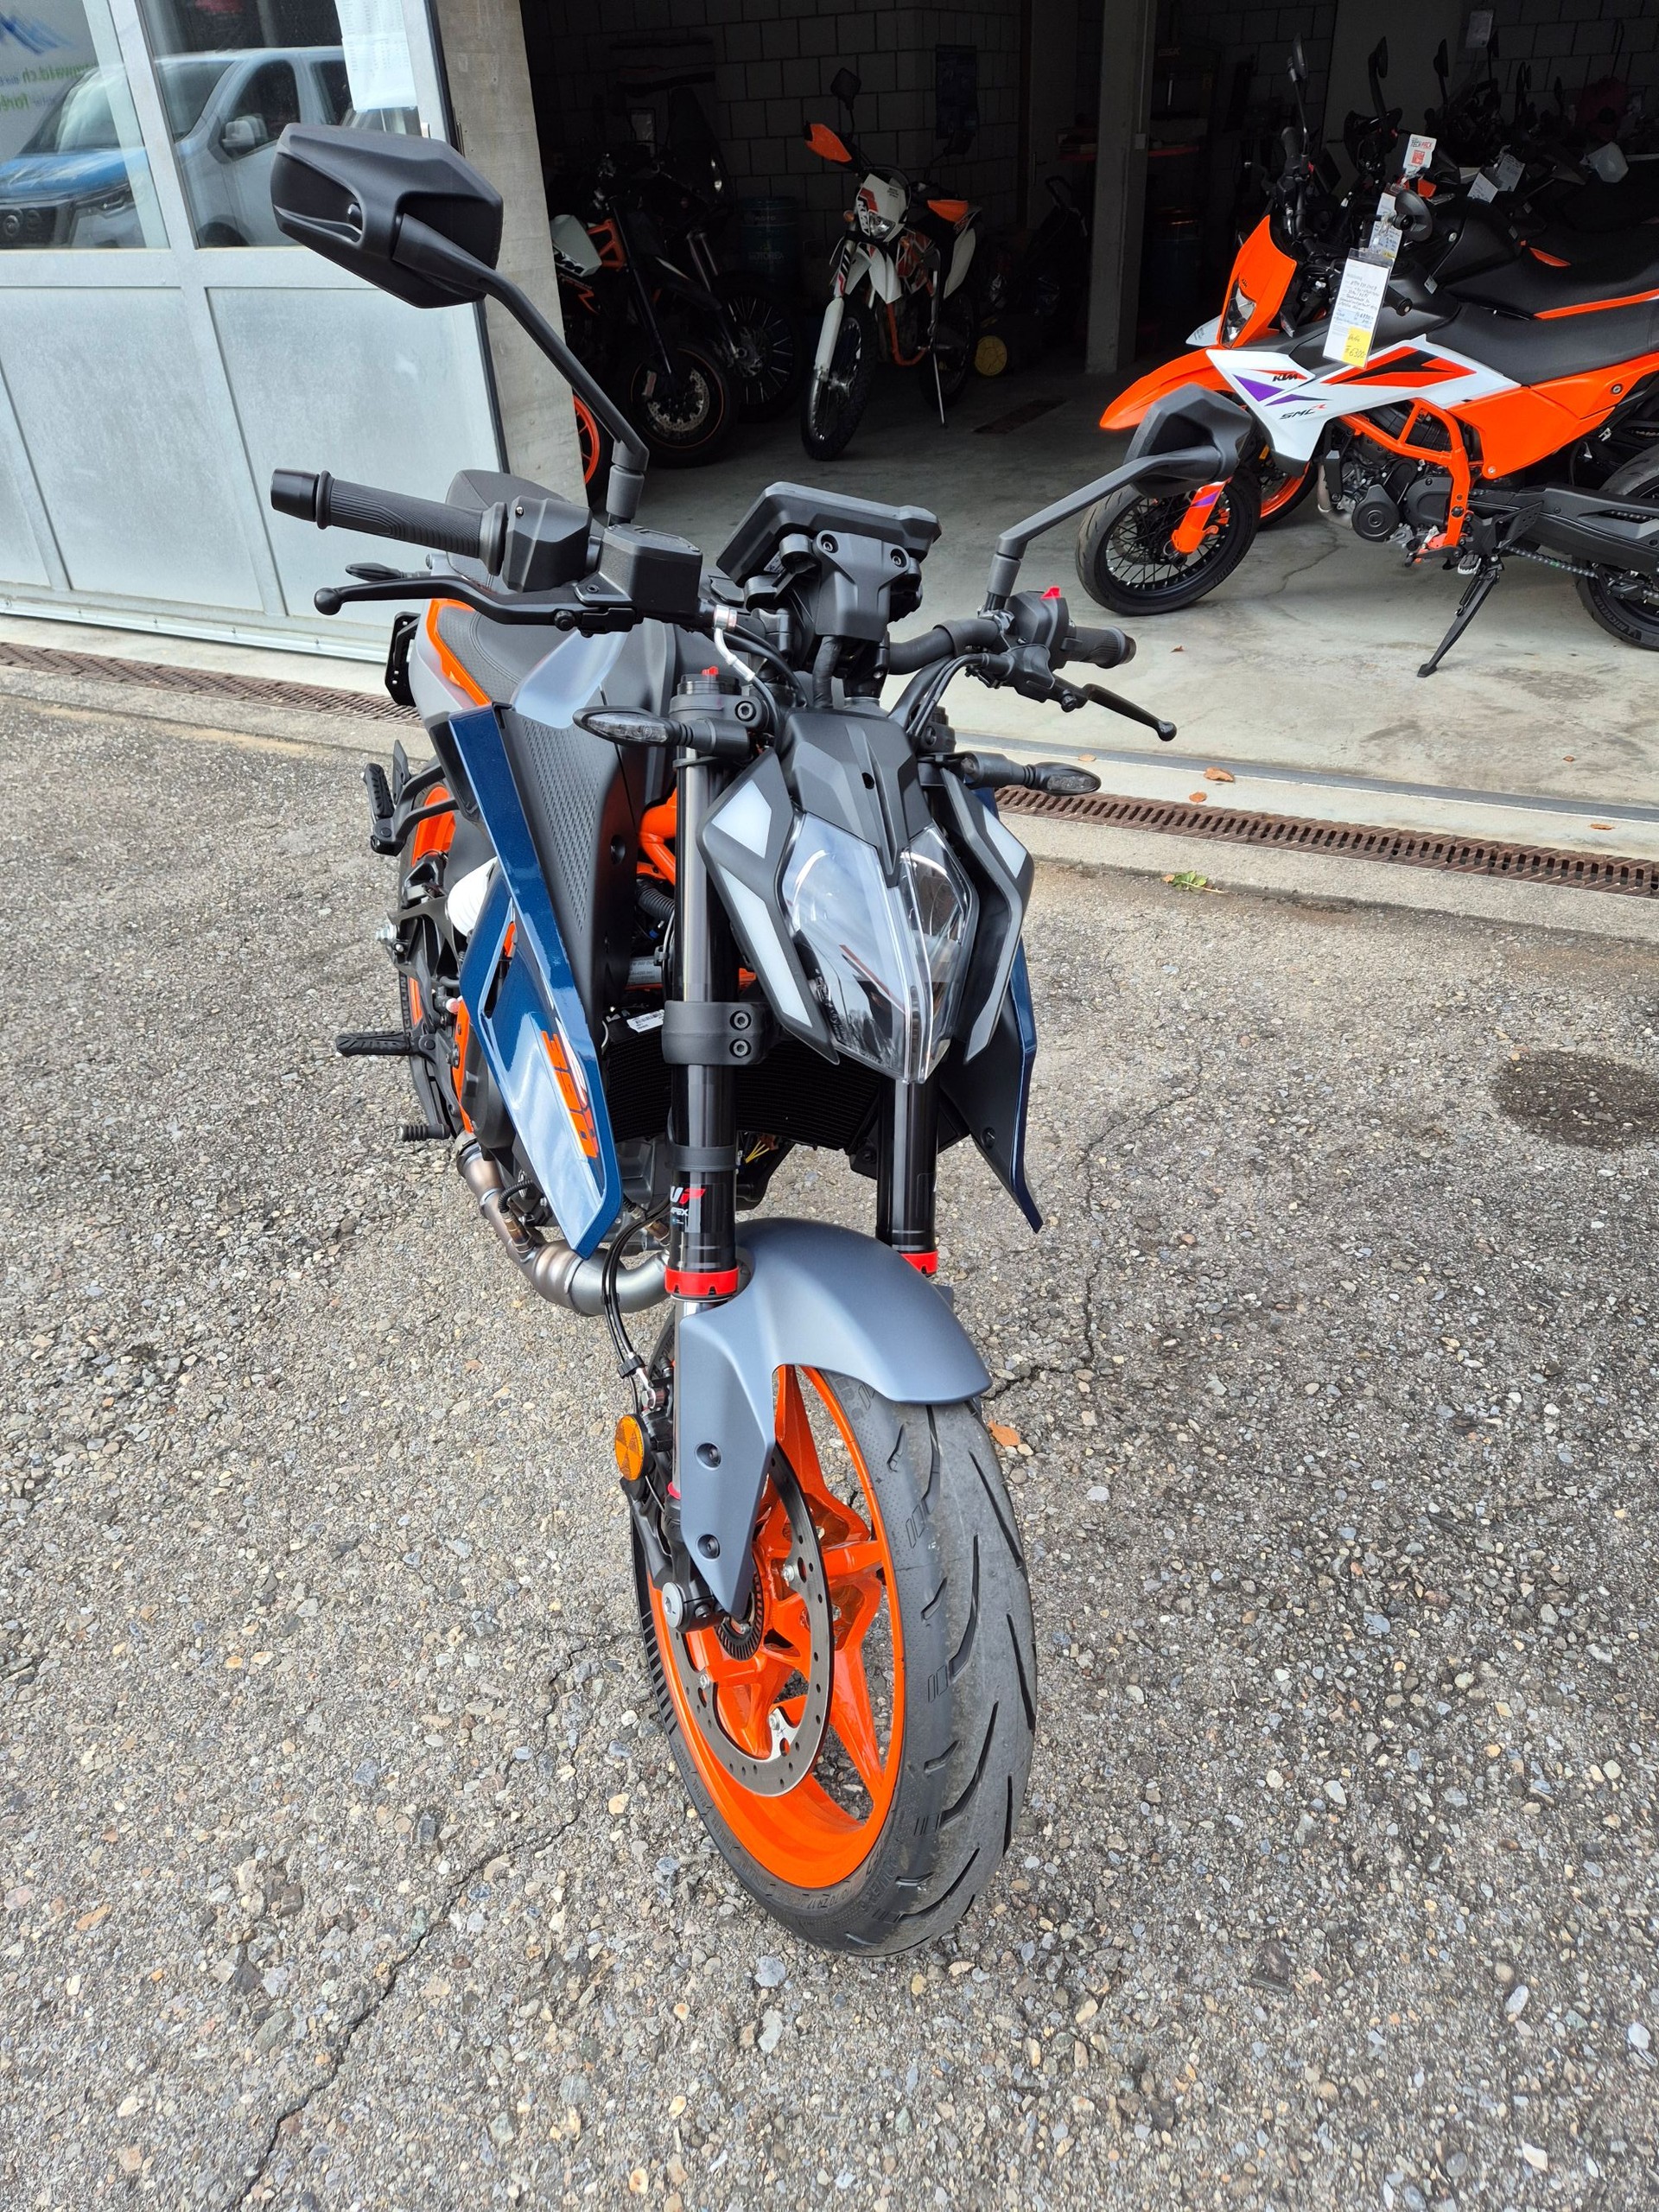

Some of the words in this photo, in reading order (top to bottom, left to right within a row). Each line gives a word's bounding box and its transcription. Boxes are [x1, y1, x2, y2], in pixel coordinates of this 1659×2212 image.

[1272, 373, 1298, 382] KTM
[1280, 409, 1315, 420] SMC
[400, 976, 410, 1032] CHELIN
[541, 1030, 598, 1159] 390
